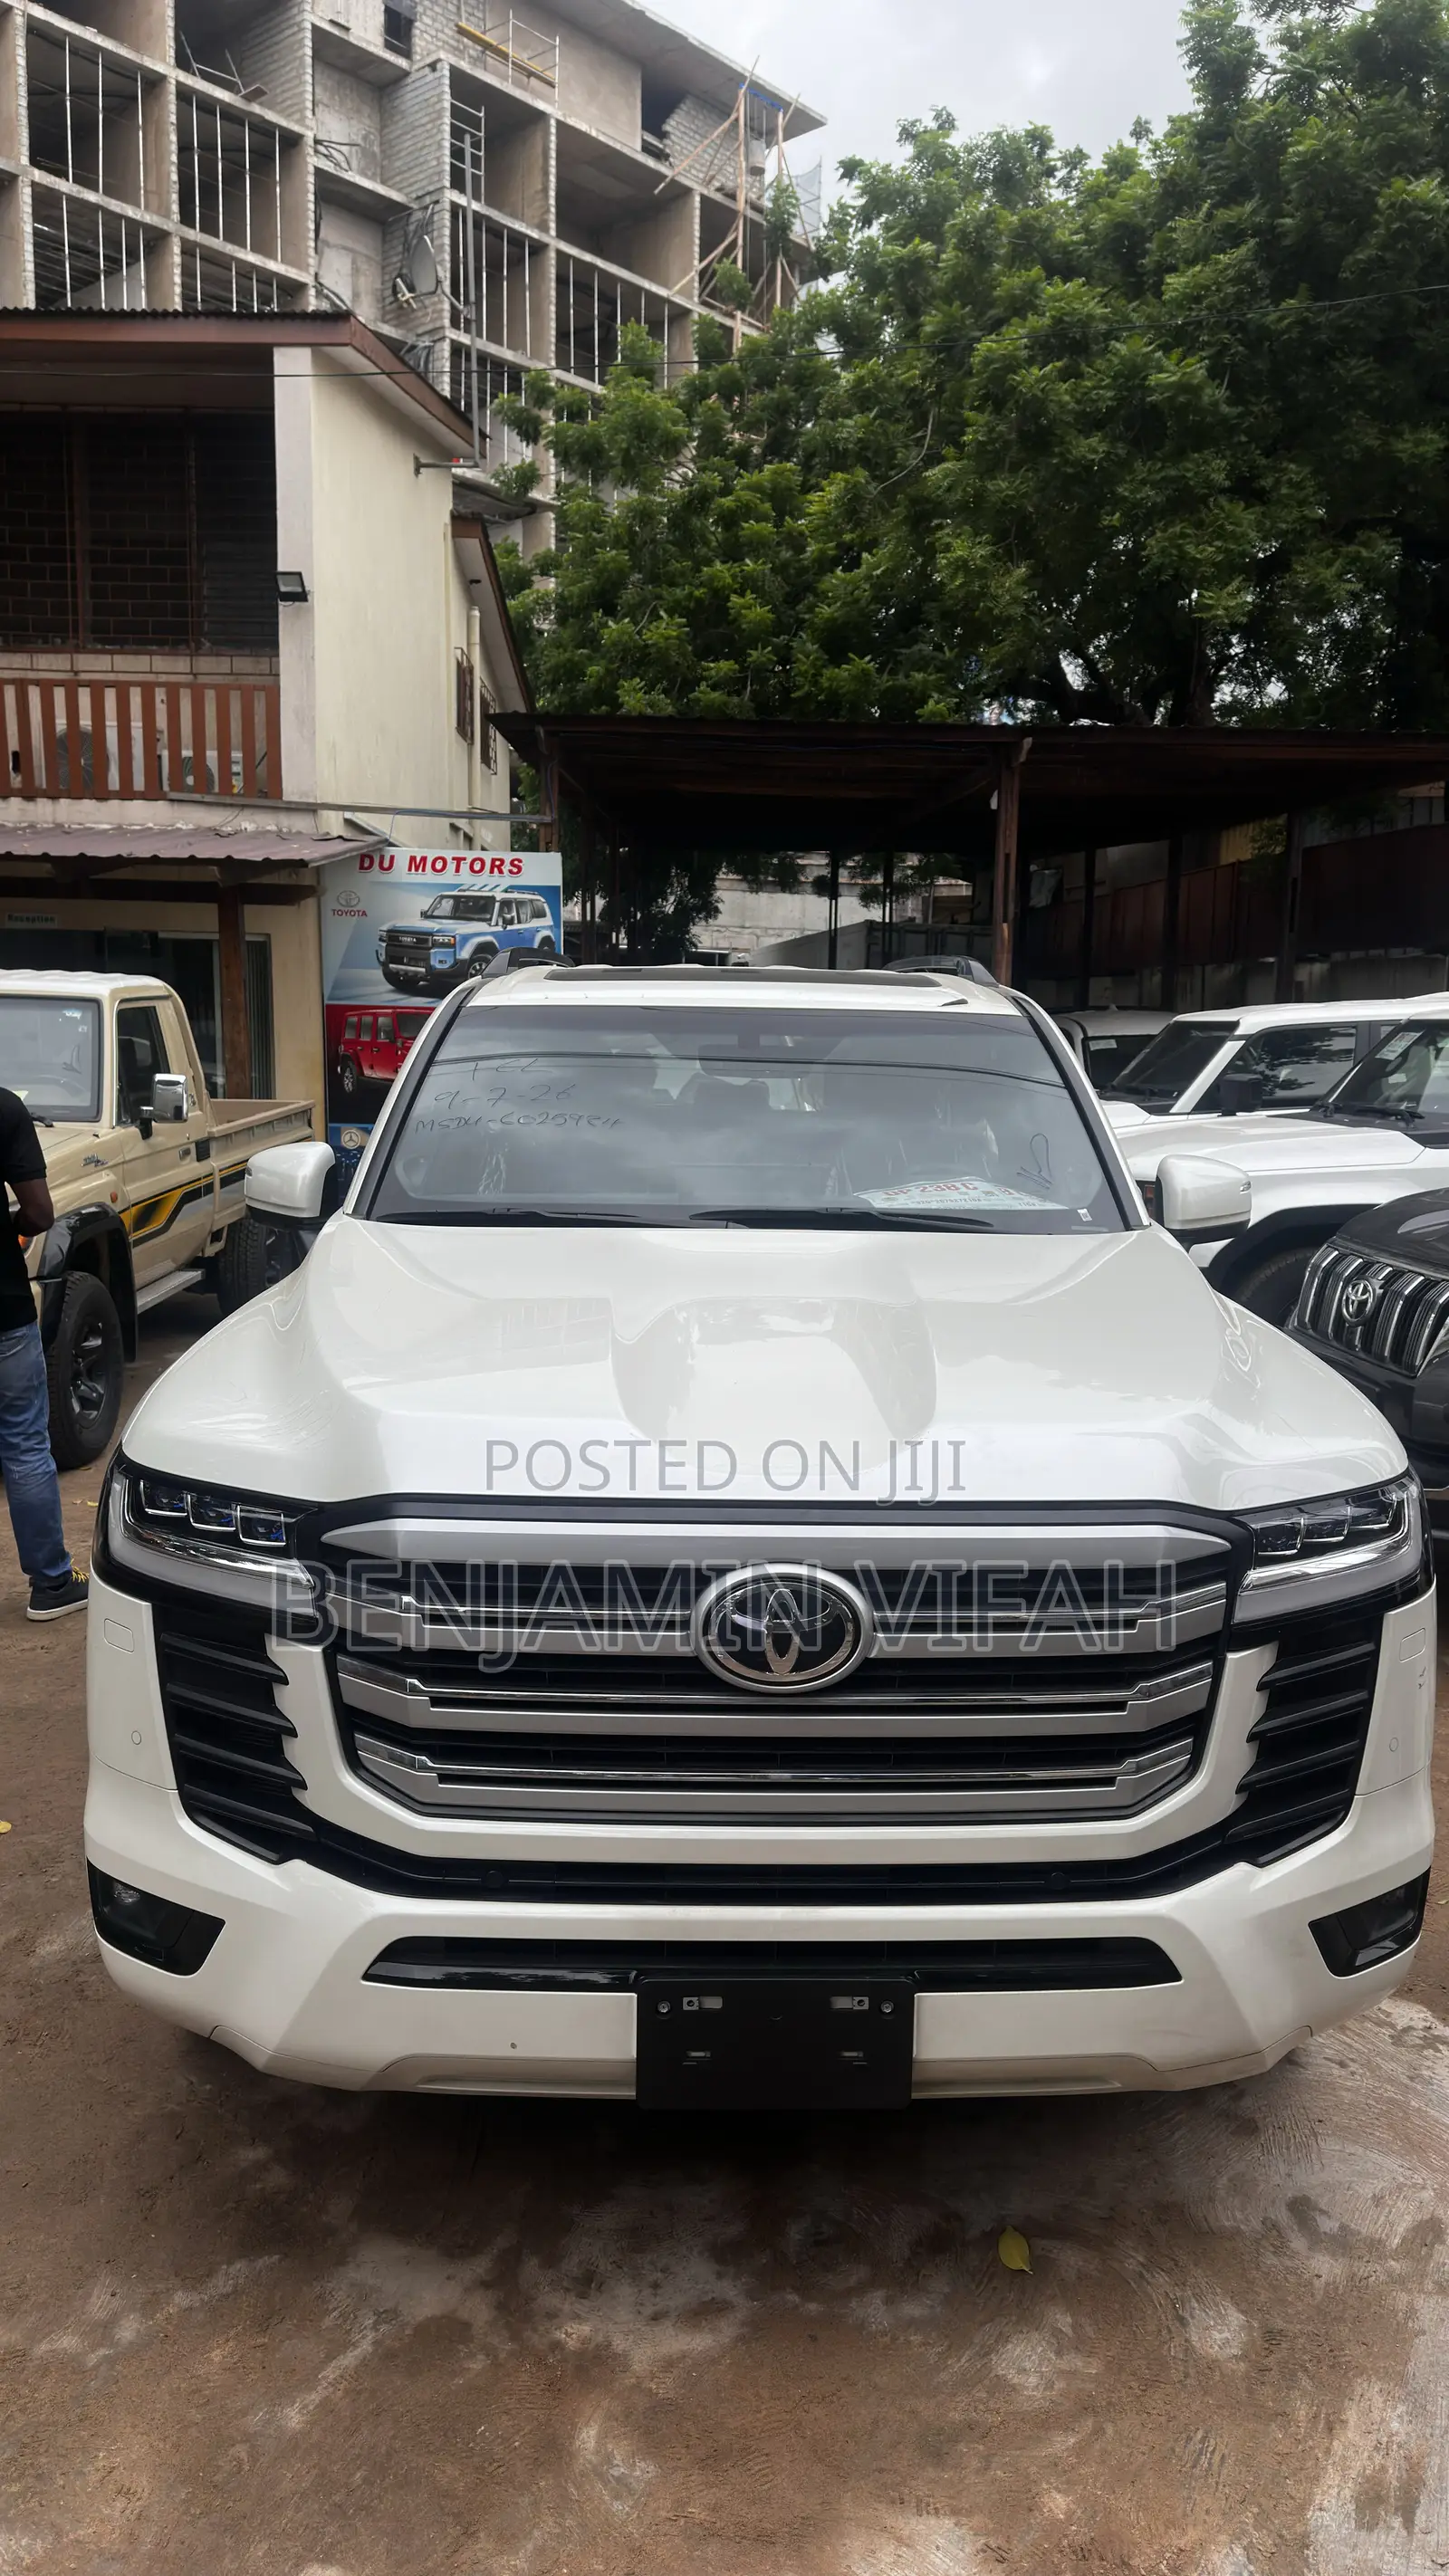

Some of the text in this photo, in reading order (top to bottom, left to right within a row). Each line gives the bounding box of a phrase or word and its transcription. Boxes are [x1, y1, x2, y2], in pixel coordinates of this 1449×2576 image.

[359, 854, 524, 876] DU MOTORS
[331, 908, 368, 917] TOYOTA
